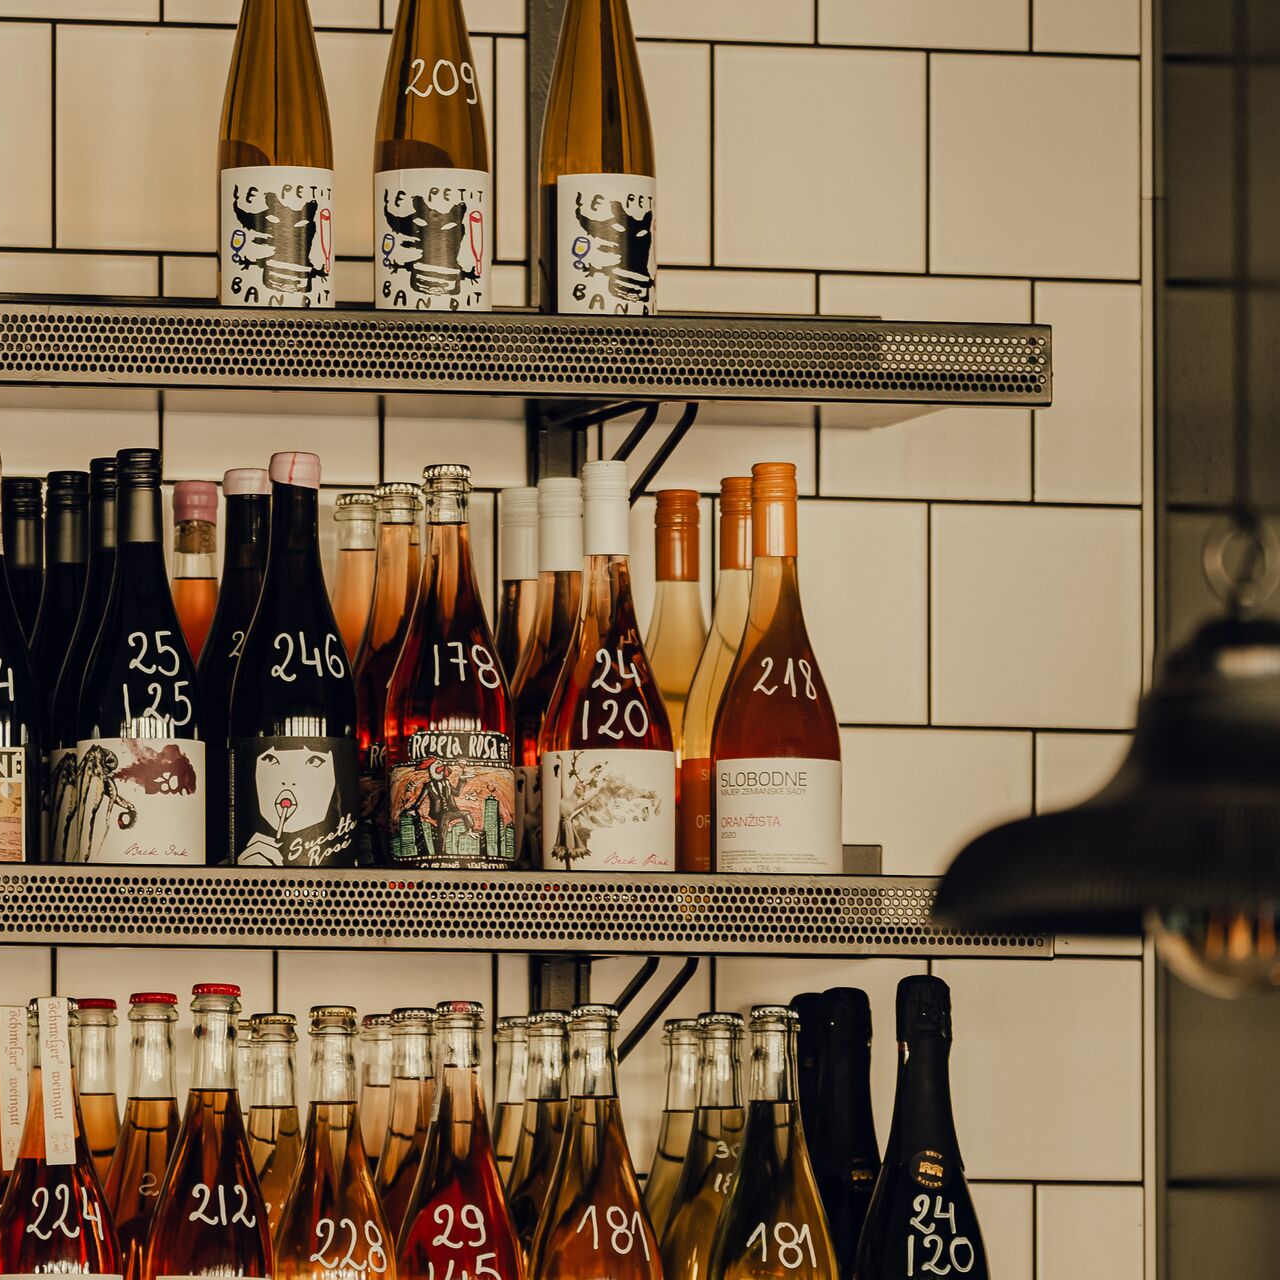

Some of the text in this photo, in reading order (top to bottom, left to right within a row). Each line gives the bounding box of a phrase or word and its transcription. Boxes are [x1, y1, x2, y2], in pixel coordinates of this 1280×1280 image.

[405, 58, 478, 105] 209
[233, 184, 331, 204] LE PETIT
[384, 187, 483, 208] LE PETIT
[575, 191, 604, 211] LE
[231, 276, 330, 308] BANDIT
[382, 280, 482, 311] BANDIT
[128, 630, 180, 677] 25
[271, 631, 345, 683] 246
[433, 642, 500, 690] 178
[590, 648, 641, 693] 24
[752, 656, 817, 701] 218
[123, 680, 192, 728] 125
[581, 699, 649, 740] 120
[720, 771, 807, 788] SLOBODNE
[721, 813, 781, 828] ORANŽISTA
[308, 835, 352, 867] Rosé
[26, 1184, 104, 1241] 224
[189, 1183, 257, 1228] 212
[432, 1205, 486, 1249] 29
[910, 1193, 956, 1234] 24
[310, 1218, 387, 1273] 228
[576, 1205, 650, 1261] 181
[746, 1222, 818, 1269] 181
[907, 1234, 974, 1277] 120
